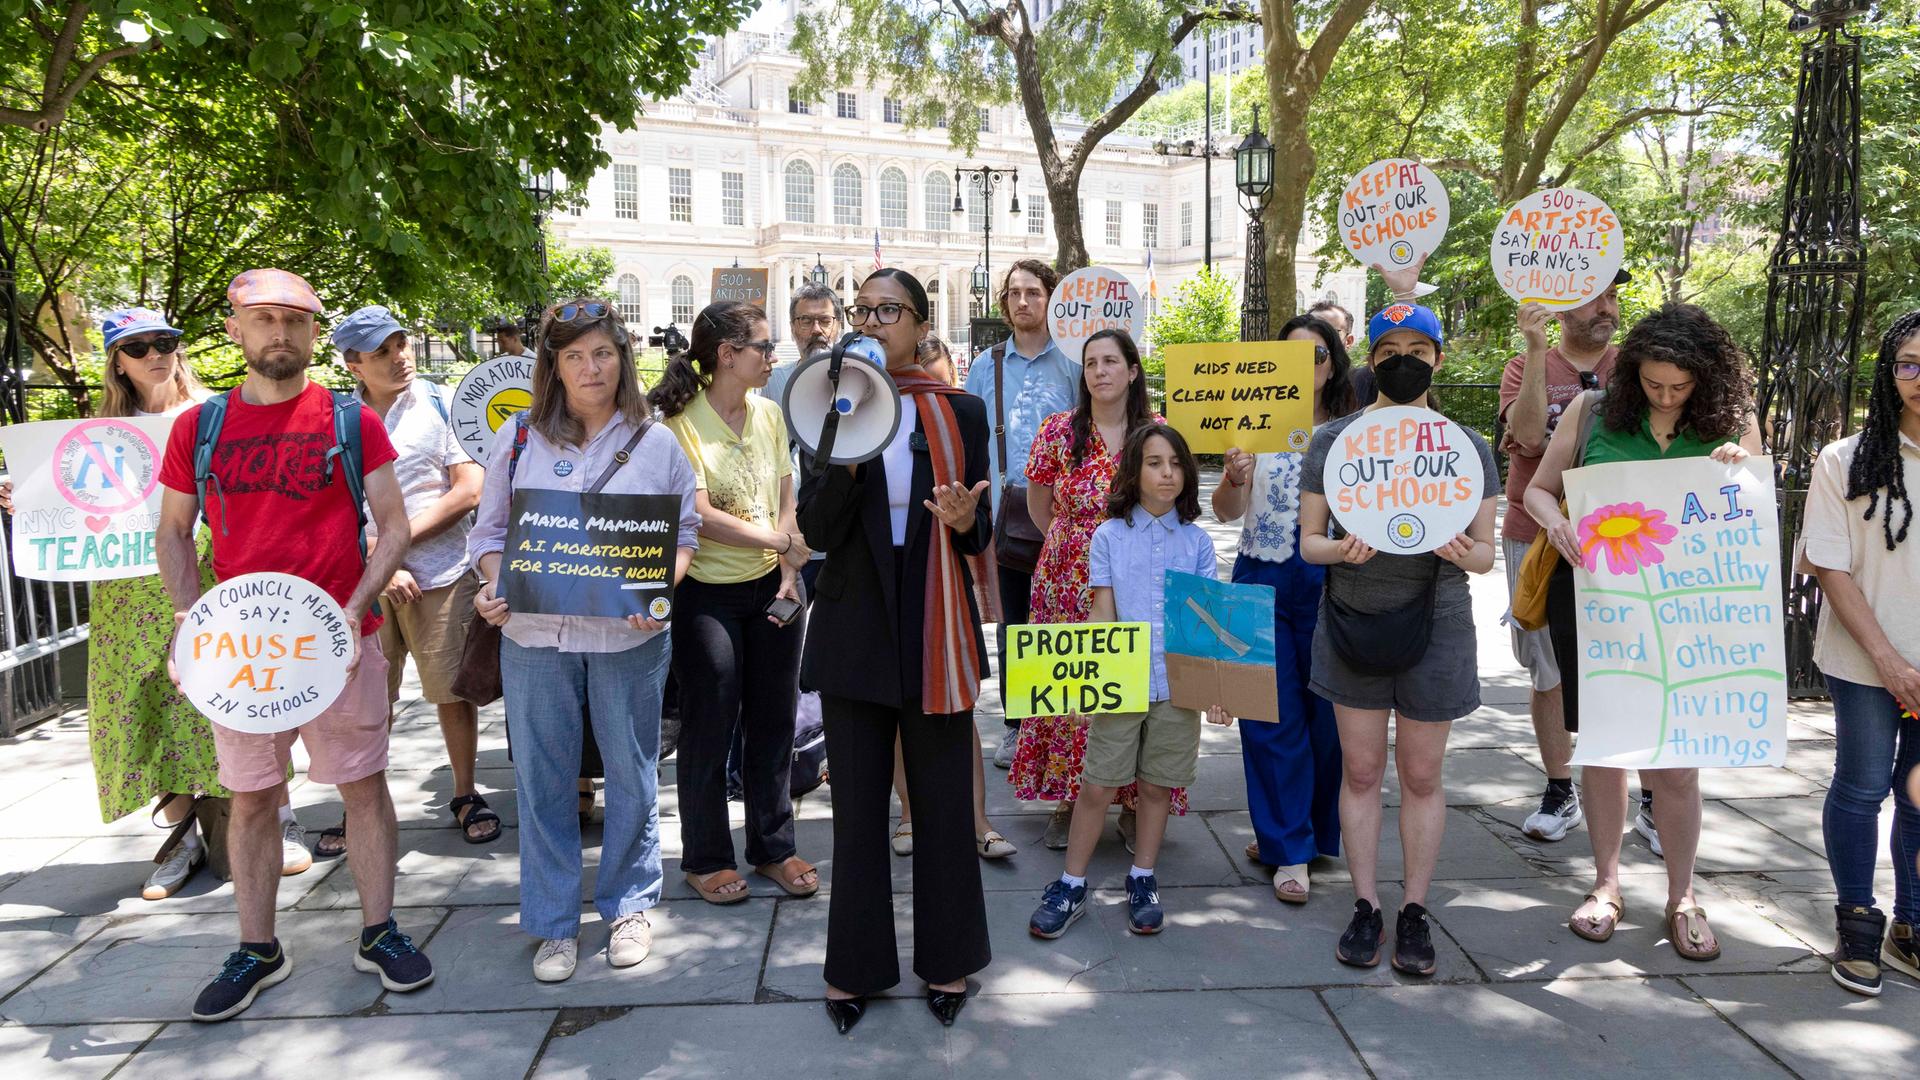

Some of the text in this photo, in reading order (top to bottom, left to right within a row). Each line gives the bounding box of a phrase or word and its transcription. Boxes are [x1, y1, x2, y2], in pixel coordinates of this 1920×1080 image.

[1345, 162, 1422, 210] KEEP AI
[1542, 190, 1586, 210] 500+
[1344, 186, 1427, 227] OUT OF OUR
[1506, 207, 1616, 234] ARTISTS
[1349, 207, 1437, 249] SCHOOLS
[1500, 231, 1530, 249] SAY
[1538, 234, 1561, 252] NO
[1509, 250, 1590, 272] FOR NYC'S
[715, 288, 762, 300] ARTISTS
[720, 273, 752, 286] 500+
[1062, 277, 1128, 302] KEEP AI
[1503, 269, 1597, 297] SCHOOLS
[1054, 301, 1133, 319] OUT OF OUR
[1194, 361, 1277, 375] KIDS NEED
[458, 361, 533, 441] A.I. MORATORI
[1172, 385, 1300, 402] CLEAN WATER
[1200, 414, 1271, 430] NOT A.I.
[1344, 418, 1417, 460] KEEP
[1415, 421, 1451, 452] AI
[212, 440, 324, 492] MORE
[1339, 451, 1460, 487] OUT OF OUR
[1337, 477, 1472, 513] SCHOOLS
[1682, 484, 1753, 524] A.I.
[20, 507, 77, 534] NYC
[29, 532, 157, 571] TEACHE
[519, 539, 663, 559] A.I. MORATORIUM
[1683, 519, 1763, 556] is not
[510, 560, 667, 580] FOR SCHOOLS NOW!
[1658, 551, 1769, 590] healthy
[191, 580, 348, 658] 29 COUNCIL MEMBERS
[240, 606, 290, 624] SAY:
[1584, 600, 1634, 624] for
[193, 631, 319, 661] PAUSE
[1017, 627, 1140, 659] PROTECT
[1587, 633, 1765, 668] and other
[1052, 661, 1099, 680] OUR
[207, 686, 319, 718] IN SCHOOLS
[1031, 682, 1122, 714] KIDS
[1672, 690, 1768, 729] living
[1669, 729, 1771, 766] things
